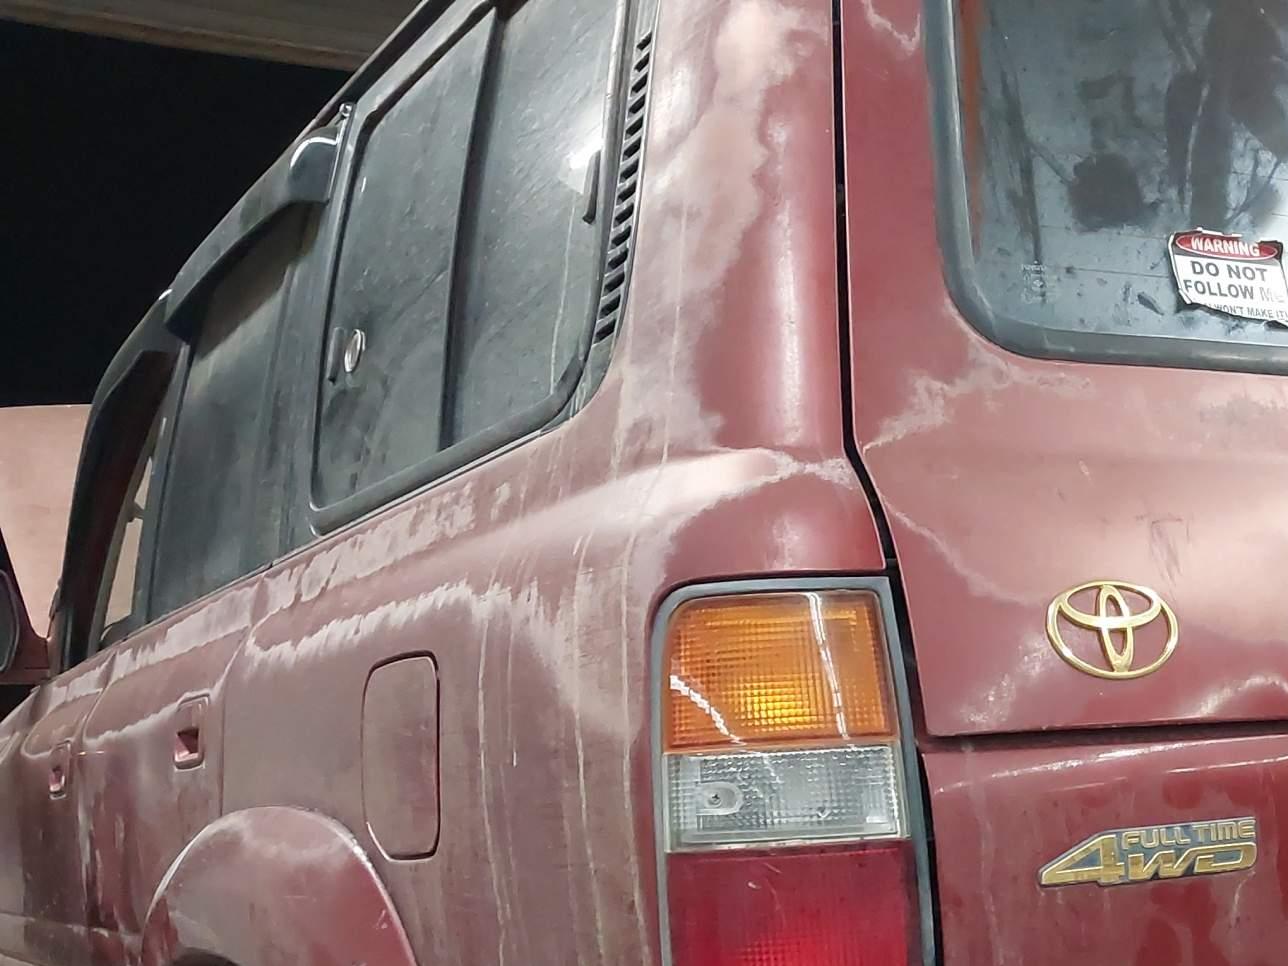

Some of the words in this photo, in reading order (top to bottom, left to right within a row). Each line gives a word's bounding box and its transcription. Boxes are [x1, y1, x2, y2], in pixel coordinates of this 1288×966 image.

[1191, 238, 1259, 257] WARNING
[1191, 261, 1219, 277] DO
[1227, 265, 1267, 281] NOT
[1184, 280, 1254, 299] FOLLOW
[1248, 307, 1273, 318] MAKE
[1121, 827, 1190, 850] FULL
[1192, 820, 1256, 843] TIME
[1041, 834, 1257, 886] 4WD
